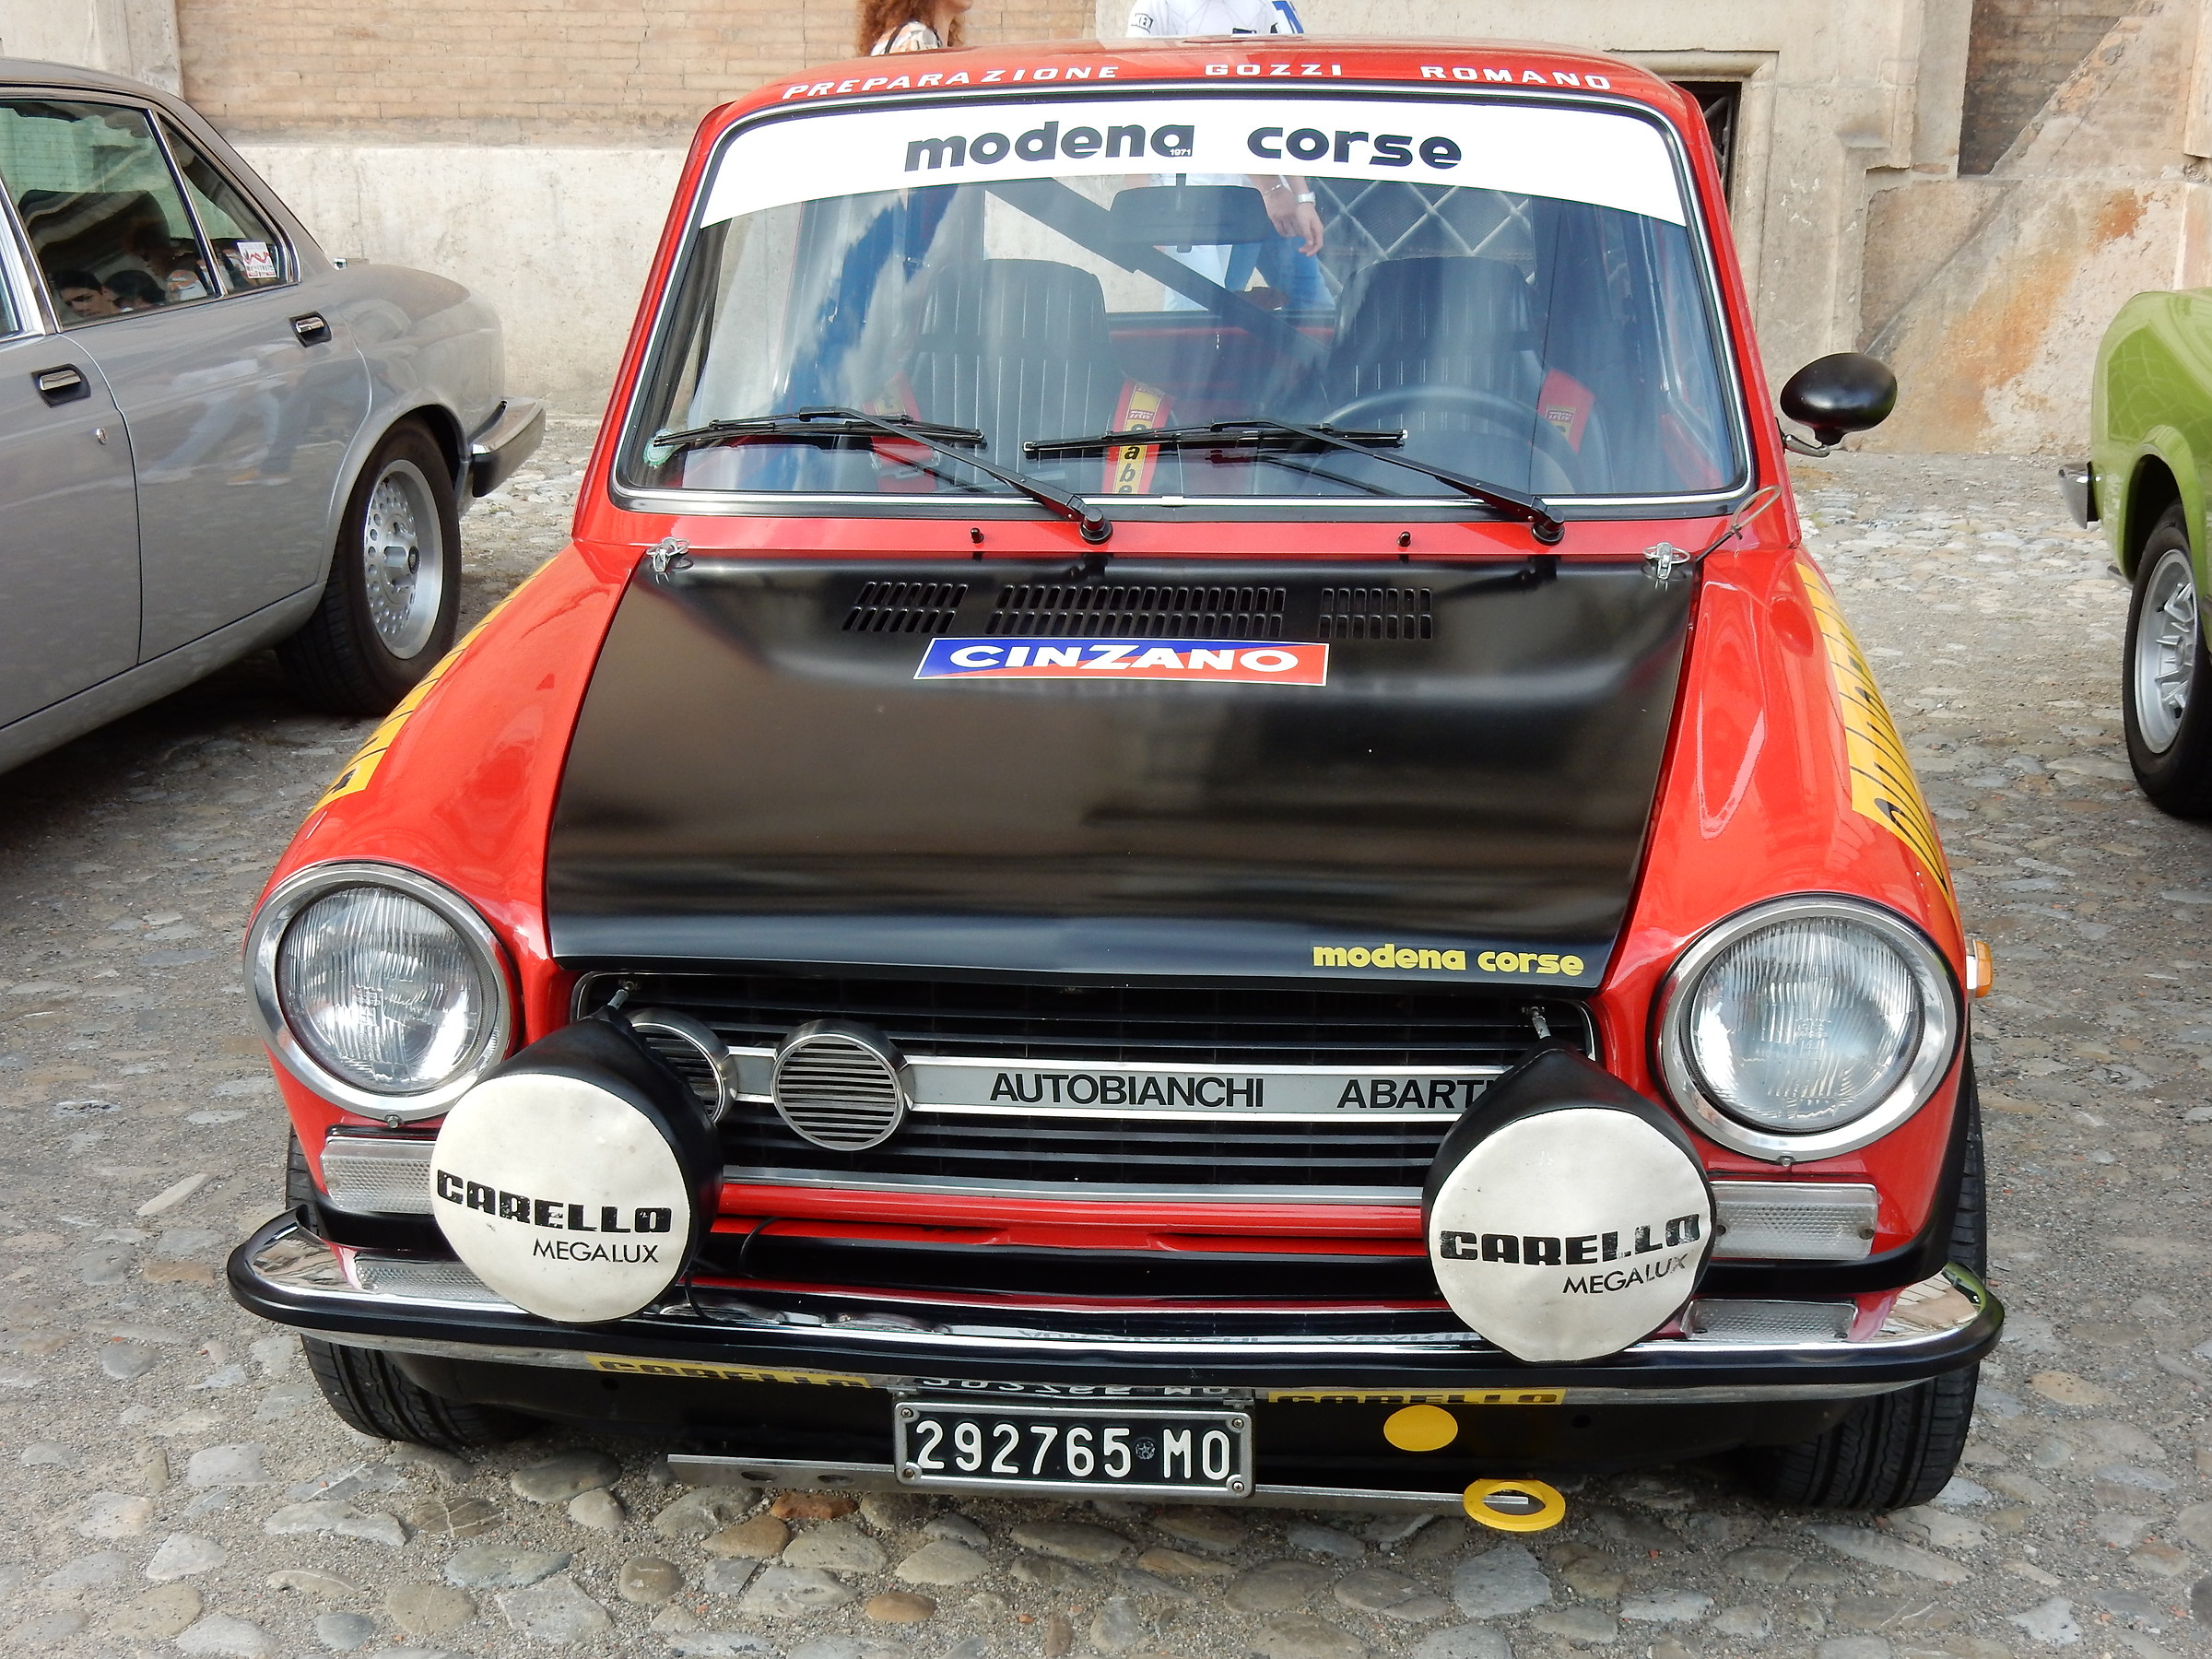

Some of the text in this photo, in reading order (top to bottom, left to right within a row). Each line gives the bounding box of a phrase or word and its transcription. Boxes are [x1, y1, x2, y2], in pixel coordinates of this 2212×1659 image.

[782, 64, 1612, 100] PREPARAZIONE GOZZI ROMANO
[903, 120, 1463, 173] modena corse
[1169, 147, 1192, 157] 1971
[948, 644, 1299, 673] CINZANO
[1312, 942, 1584, 977] modena corse
[989, 1072, 1495, 1110] AUTOBIANCHI ABART
[437, 1169, 673, 1234] CARELLO
[532, 1238, 660, 1264] MEGALUX
[1440, 1213, 1701, 1266] CARELLO
[1562, 1253, 1690, 1294] MEGALUX
[915, 1419, 1230, 1480] 292765 MO
